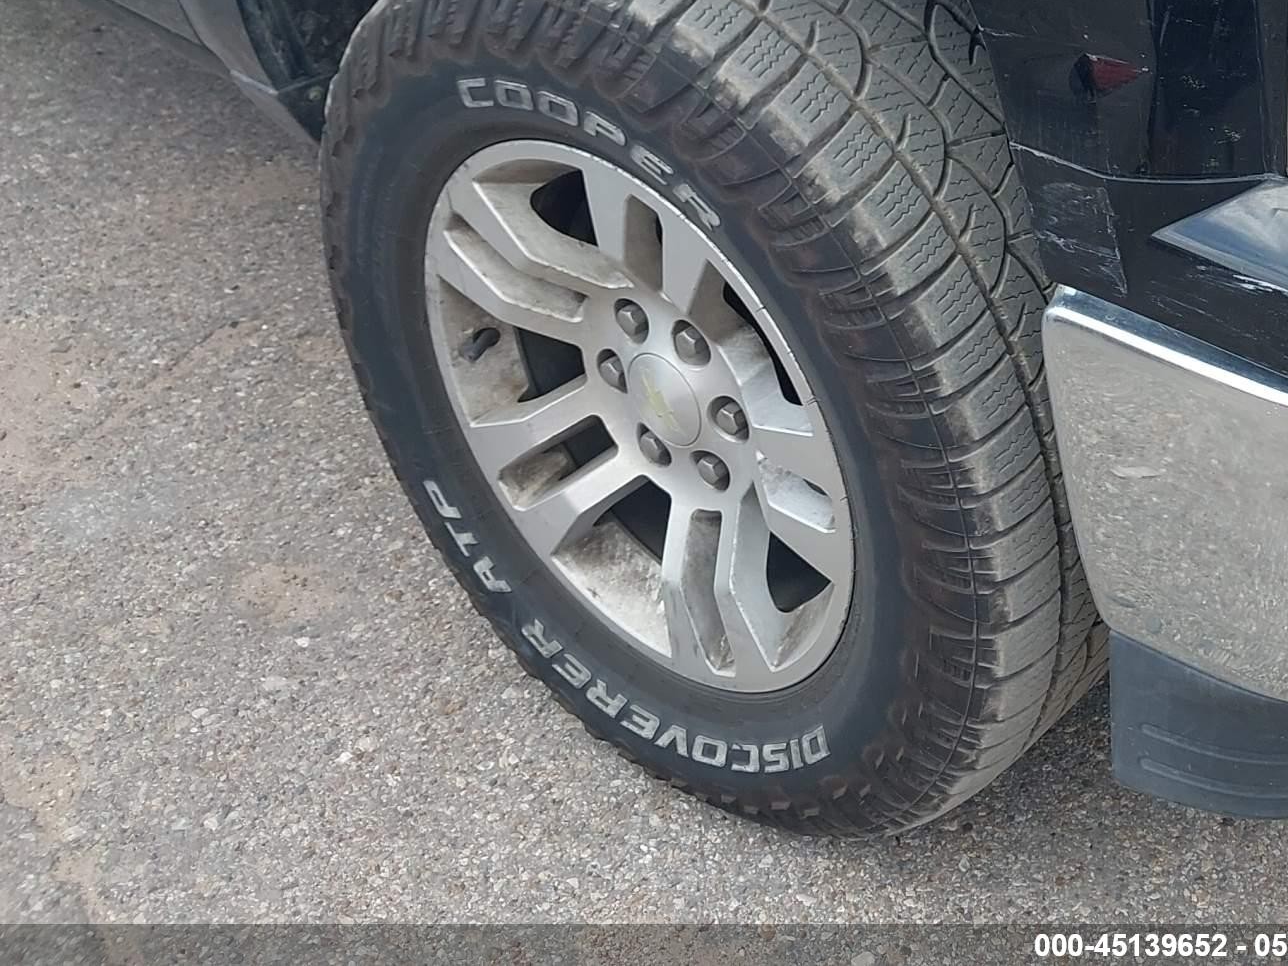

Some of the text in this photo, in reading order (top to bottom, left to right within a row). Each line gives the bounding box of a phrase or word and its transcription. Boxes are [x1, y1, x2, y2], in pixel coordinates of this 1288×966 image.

[457, 77, 721, 232] COOPER
[422, 480, 831, 774] DISCOVERER ATP
